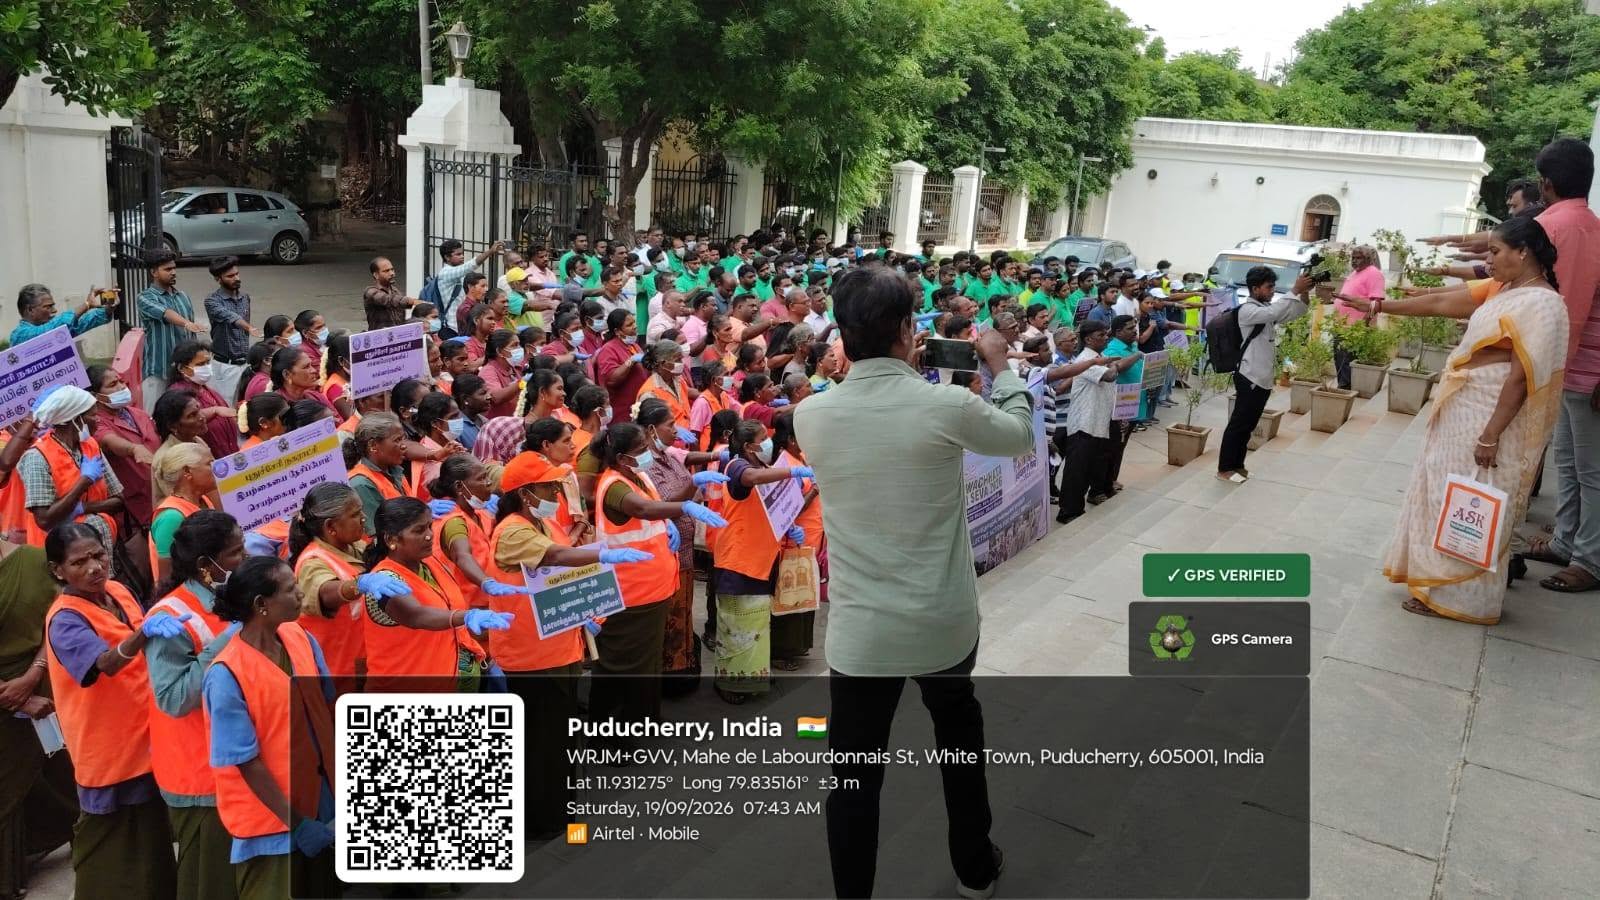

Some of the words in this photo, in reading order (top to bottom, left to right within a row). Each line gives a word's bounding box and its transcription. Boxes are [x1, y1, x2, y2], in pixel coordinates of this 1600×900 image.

[16, 354, 58, 380] நகராட்சி
[244, 460, 283, 483] புதுச்சேரி
[284, 444, 319, 467] நகராட்சி
[236, 474, 288, 503] இயற்கையை
[965, 464, 1002, 494] WACHHATA
[1452, 507, 1485, 529] ASK
